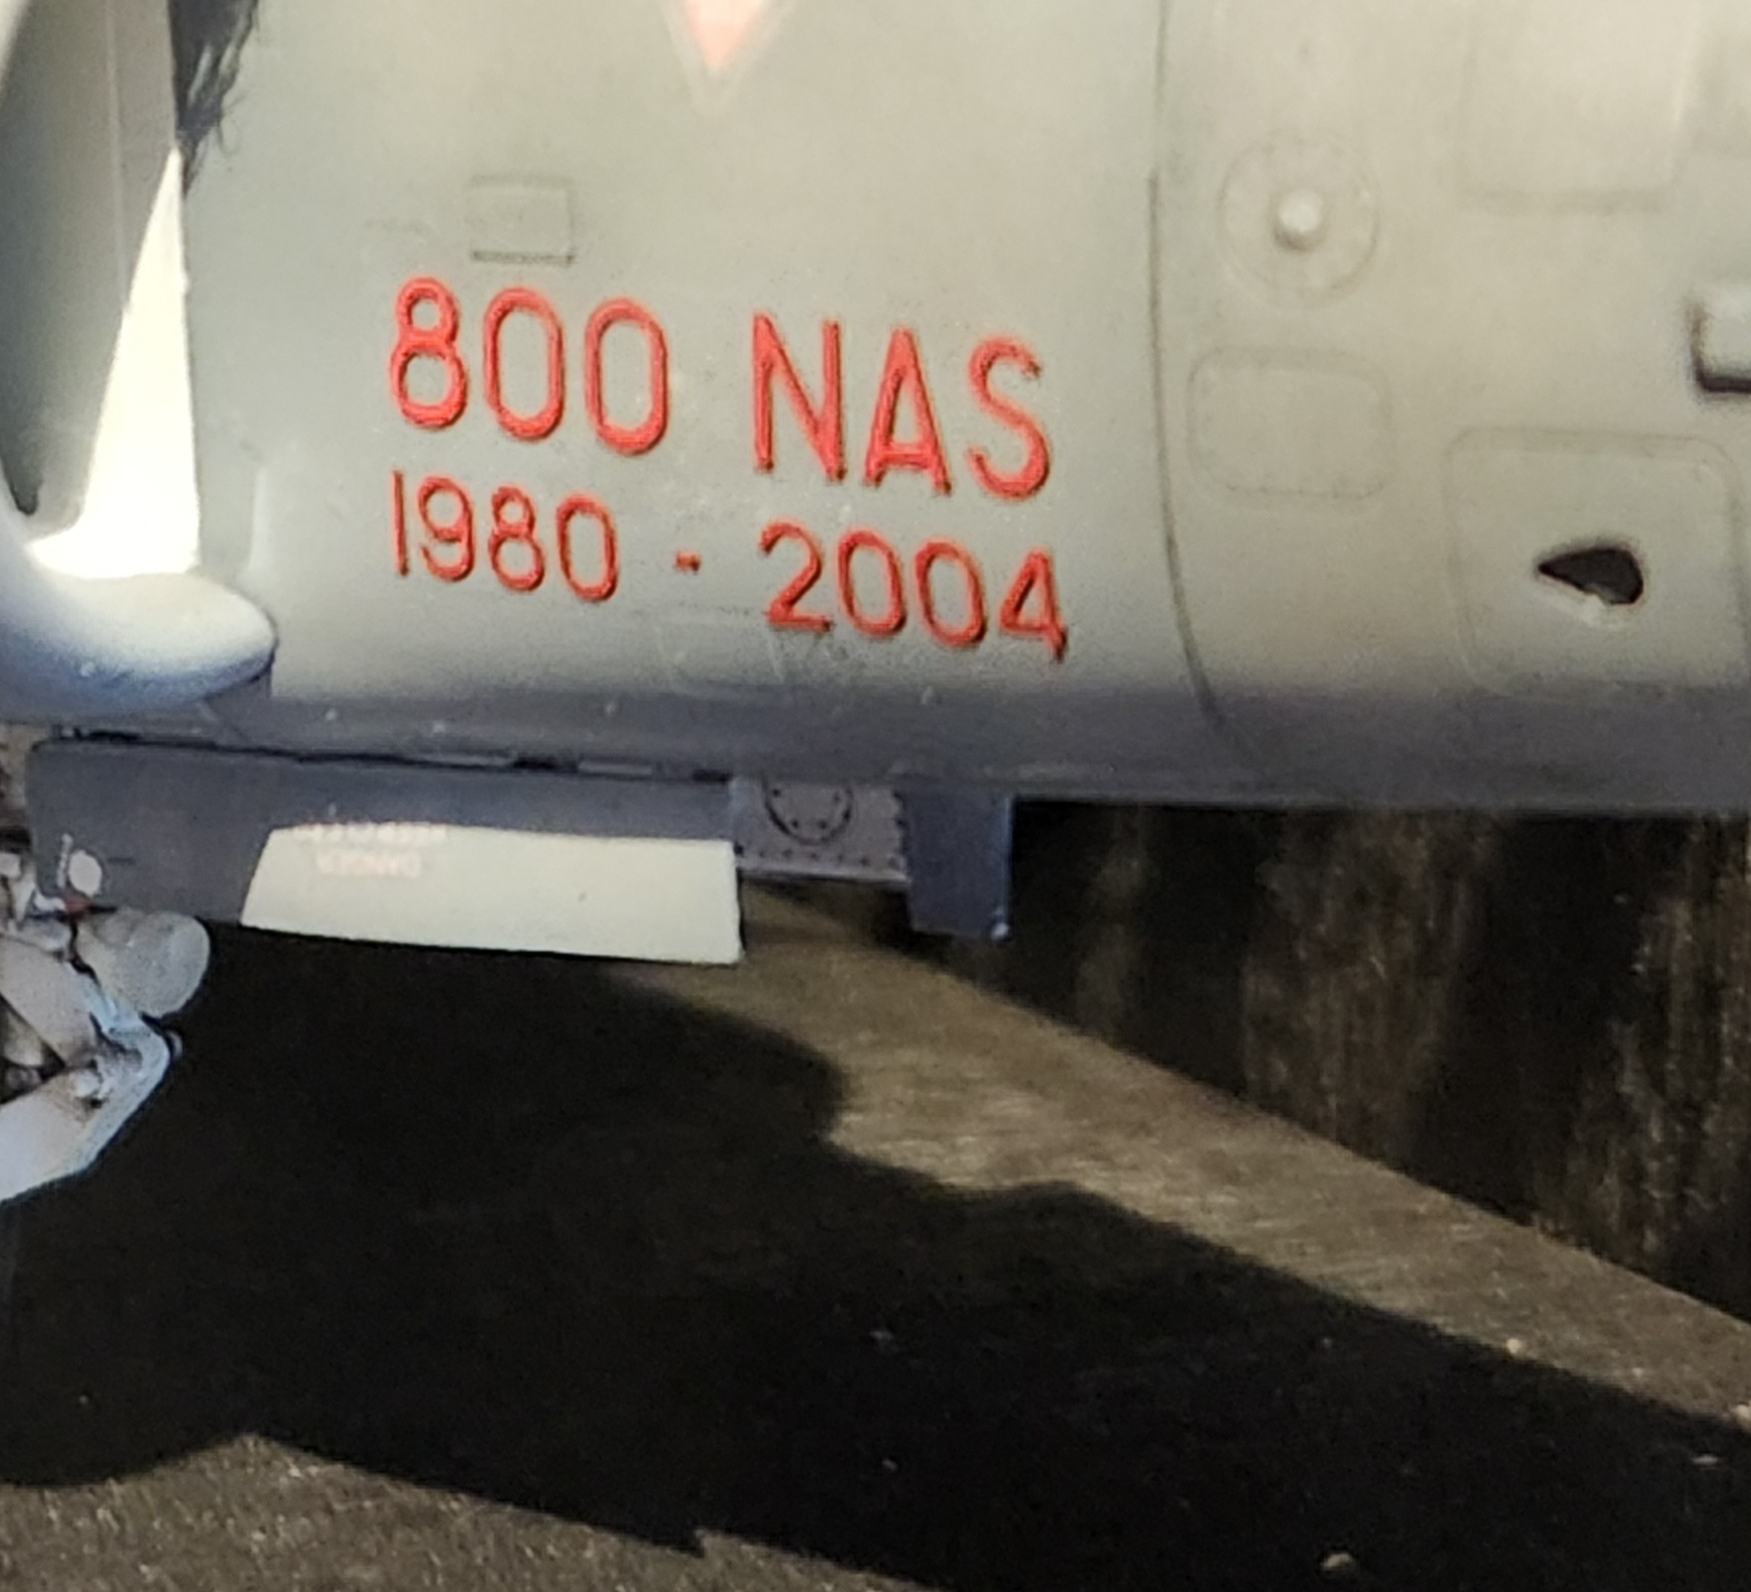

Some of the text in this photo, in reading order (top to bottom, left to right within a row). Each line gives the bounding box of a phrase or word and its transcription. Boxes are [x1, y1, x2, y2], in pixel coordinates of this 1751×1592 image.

[389, 276, 1052, 501] 800 NAS
[392, 468, 1069, 664] 1980 - 2004
